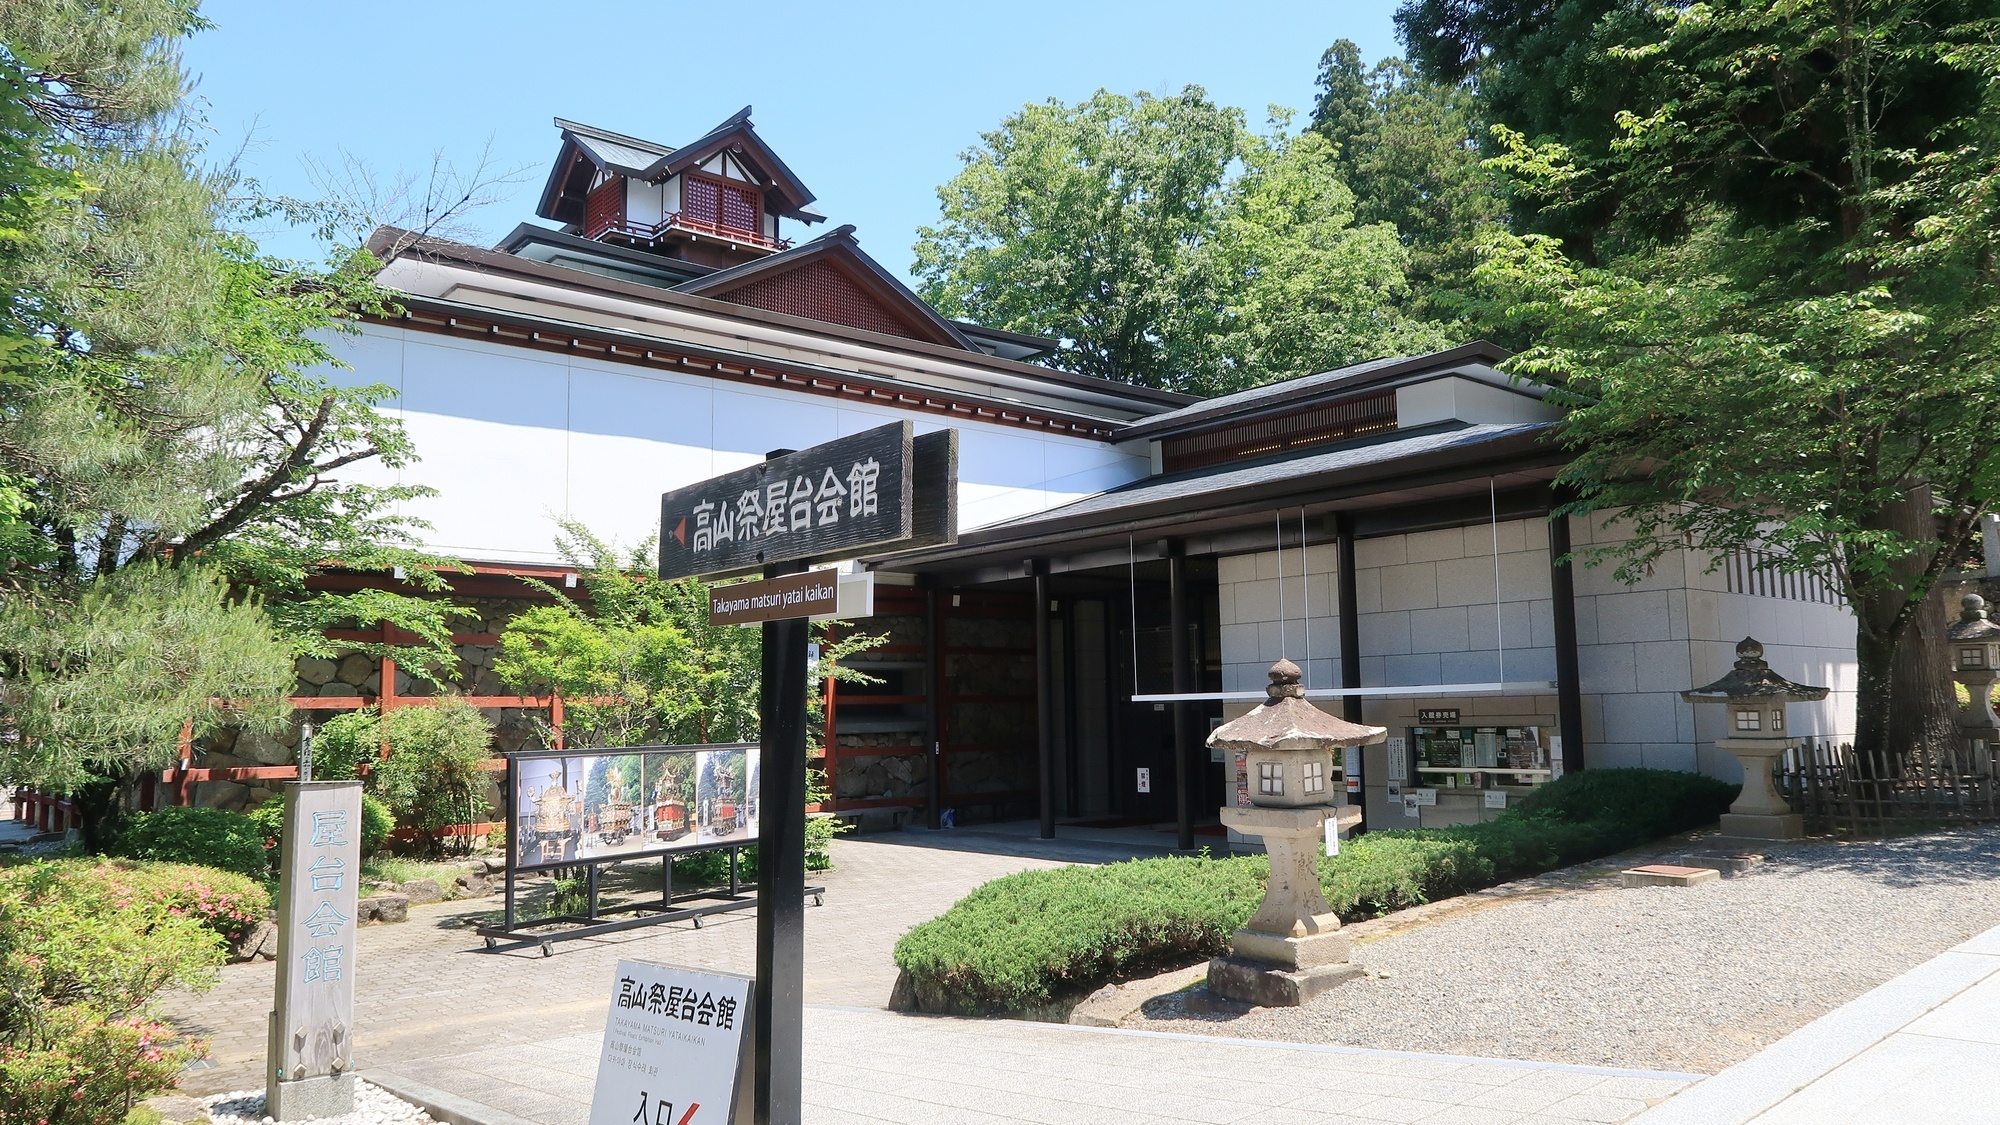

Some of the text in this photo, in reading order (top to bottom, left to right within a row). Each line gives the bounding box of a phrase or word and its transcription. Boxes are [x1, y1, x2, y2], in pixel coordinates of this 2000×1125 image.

[692, 456, 881, 553] 高山祭屋台会館
[713, 583, 834, 616] Takayama matsuri yatai kaikan
[301, 810, 351, 984] 屋台会館
[617, 975, 737, 1031] 高山祭屋台会館
[614, 1017, 706, 1047] TAKAYAMA MATSURI YATAIKAIKAN
[632, 1090, 673, 1125] 入口
